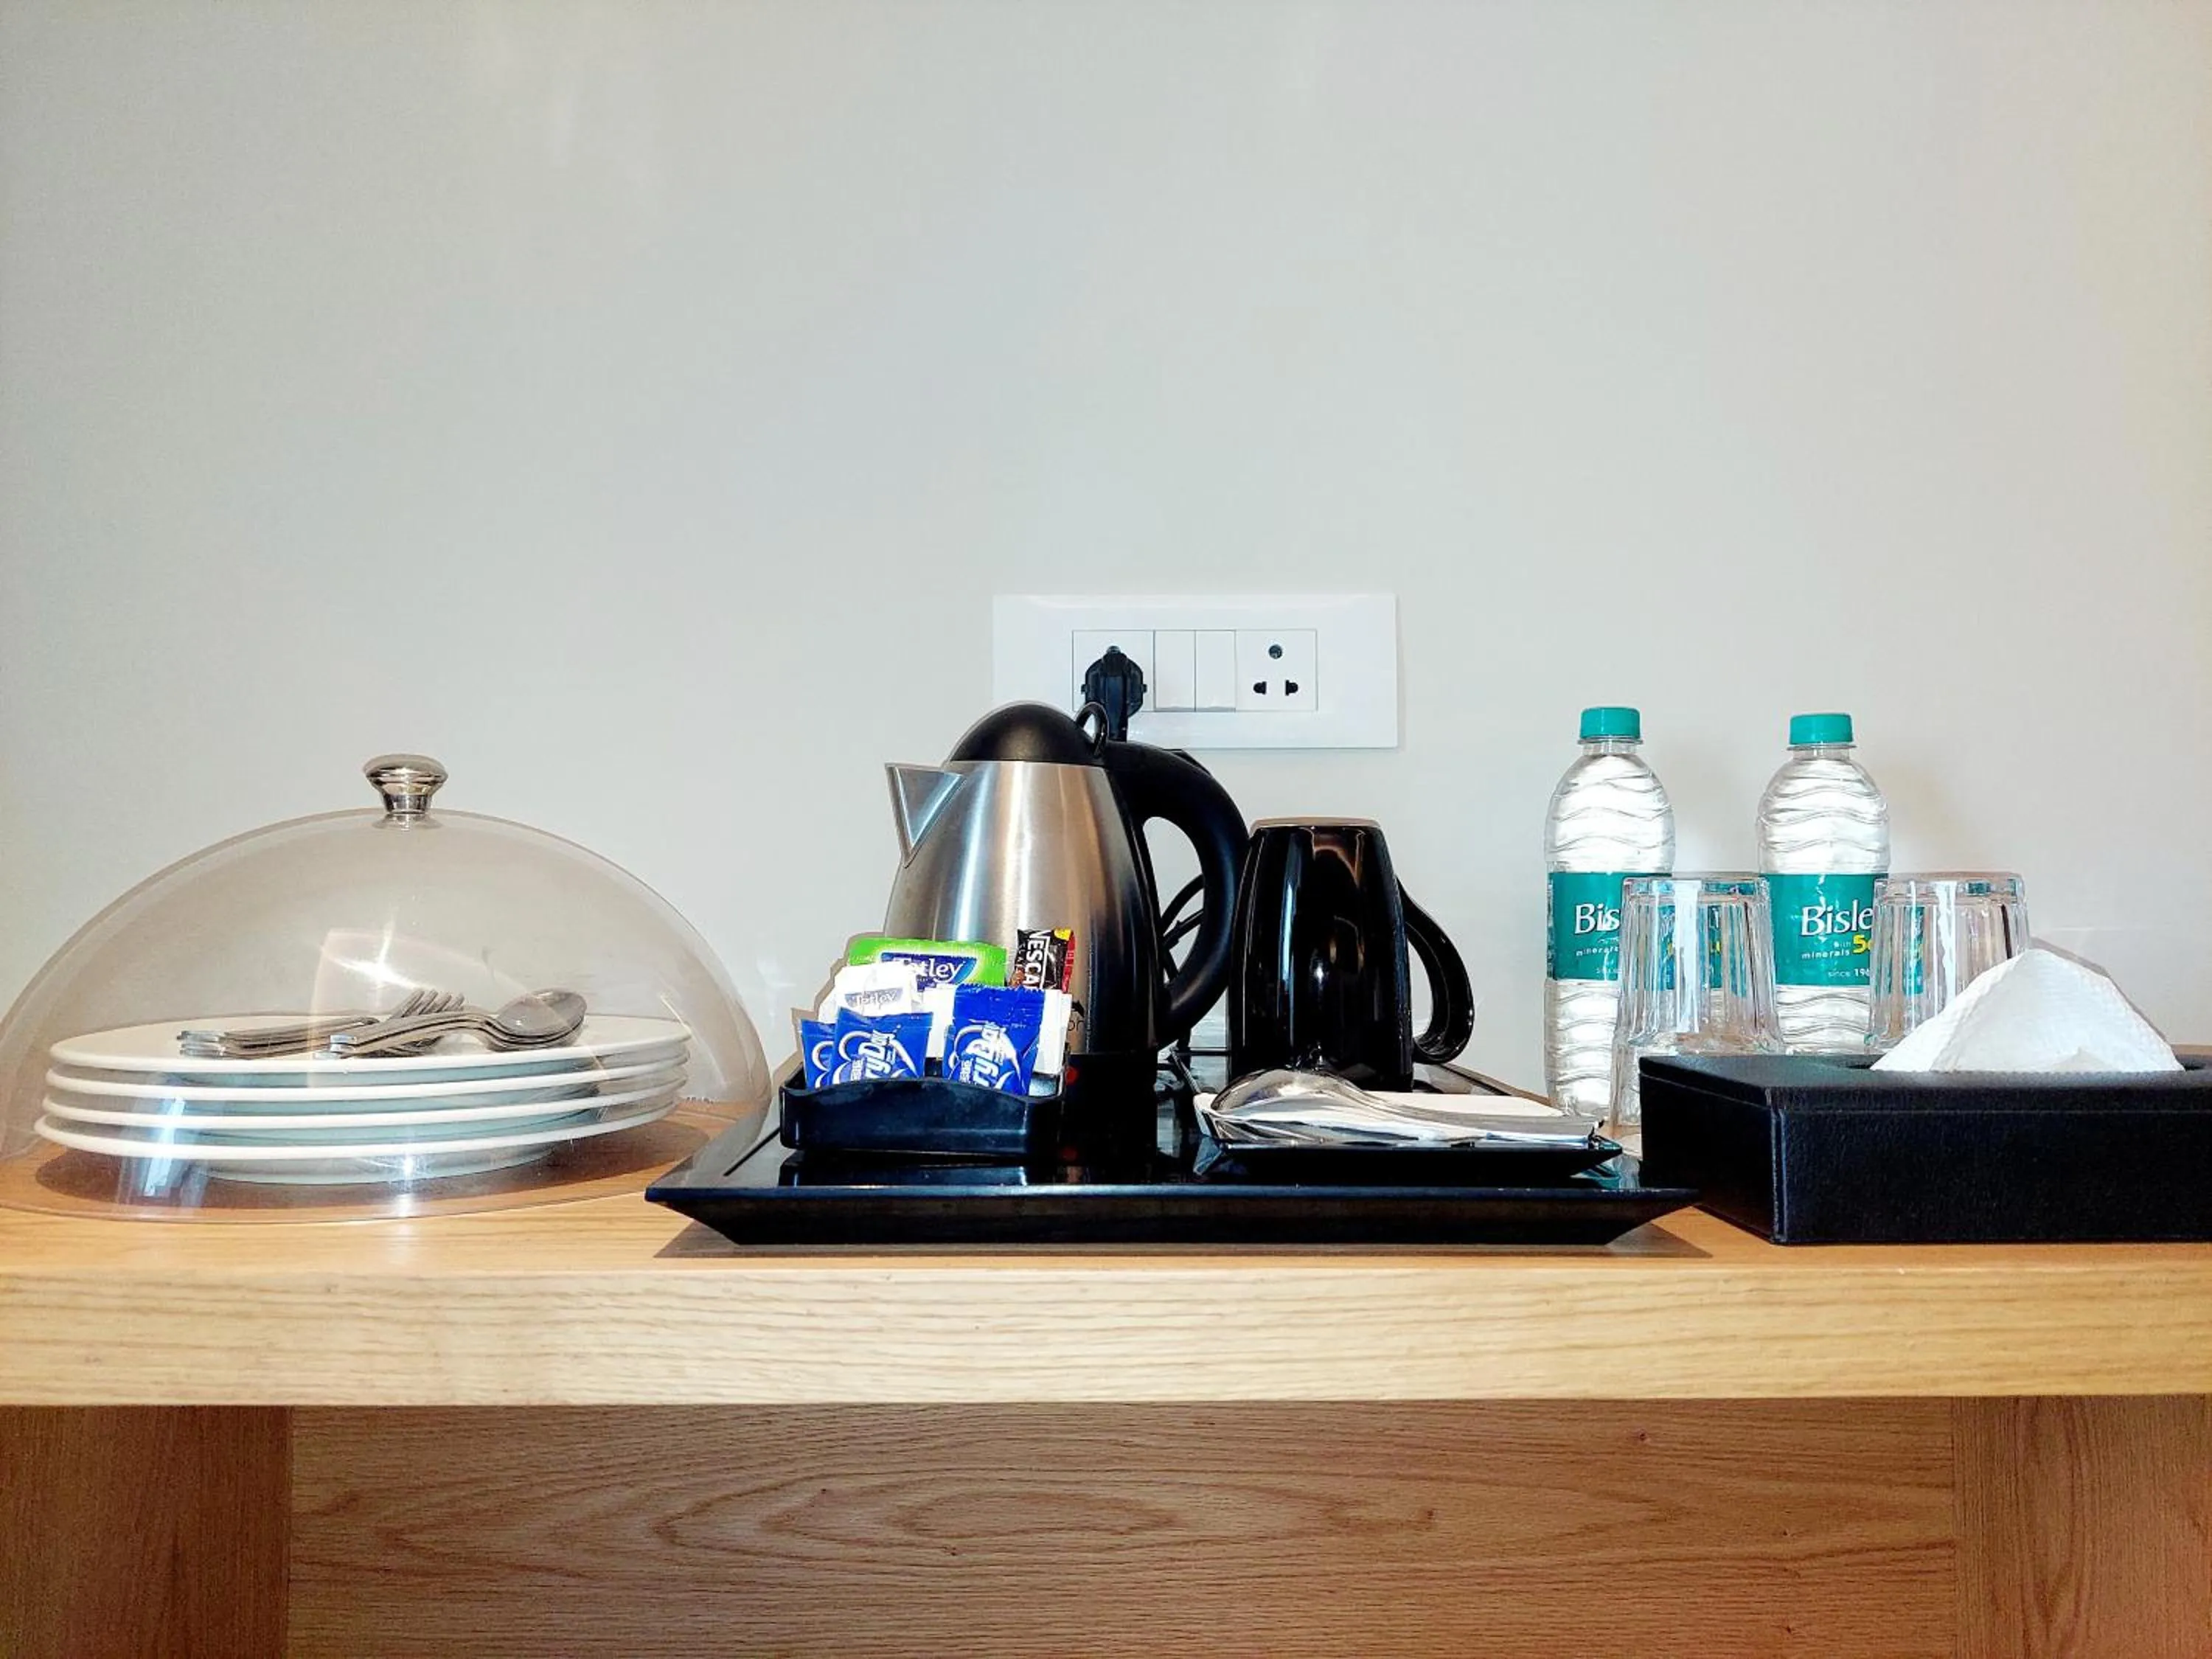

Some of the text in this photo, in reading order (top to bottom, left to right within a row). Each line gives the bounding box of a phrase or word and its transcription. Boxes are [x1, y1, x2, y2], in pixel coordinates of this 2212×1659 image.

[1801, 899, 1874, 936] Bisle
[1022, 930, 1052, 990] NESCA
[1801, 949, 1850, 959] minerals
[893, 957, 967, 984] tley
